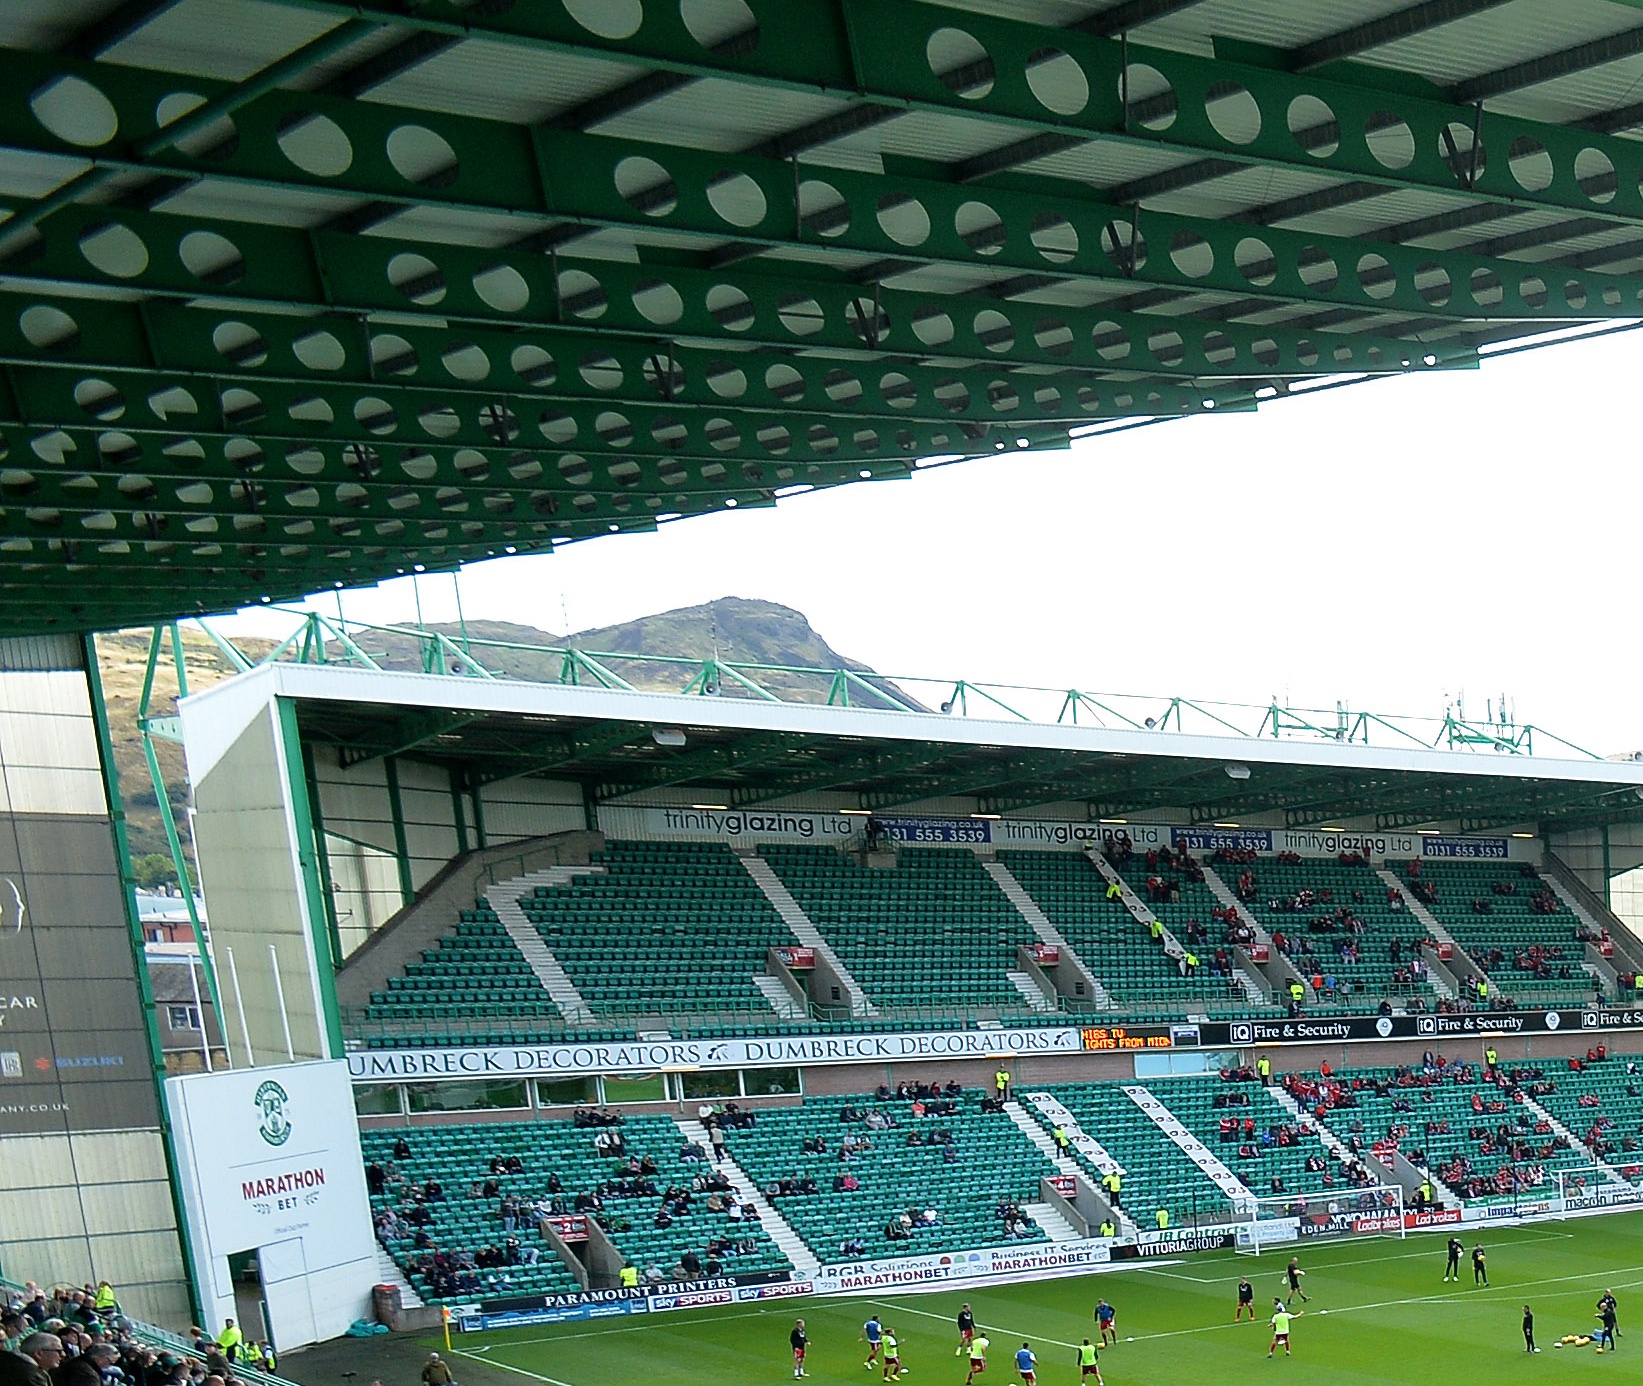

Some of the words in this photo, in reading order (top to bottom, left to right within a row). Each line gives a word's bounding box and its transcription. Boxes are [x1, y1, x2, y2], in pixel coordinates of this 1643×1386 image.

[664, 810, 814, 837] trinityglazing
[821, 816, 852, 835] Ltd
[1005, 822, 1127, 844] trinityglazing
[1133, 827, 1158, 843] Ltd
[916, 829, 943, 841] 555
[949, 830, 985, 842] 3539
[1285, 832, 1386, 854] trinityglazing
[1391, 837, 1412, 851] Ltd
[1427, 846, 1450, 856] 0131
[1455, 846, 1475, 856] 555
[1479, 847, 1504, 857] 3539
[1438, 1019, 1460, 1031] Fire
[1464, 1018, 1474, 1029] &
[1476, 1016, 1524, 1031] Security
[1601, 1013, 1621, 1025] Fire
[1625, 1013, 1633, 1023] &
[1254, 1026, 1281, 1038] Fire
[1283, 1025, 1291, 1036] &
[1293, 1022, 1351, 1038] Security
[746, 1038, 892, 1060] DUMBRECK
[900, 1032, 1049, 1054] DECORATORS
[350, 1052, 504, 1076] UMBRECK
[514, 1044, 700, 1070] DECORATORS
[242, 1168, 325, 1201] MARATHON
[278, 1197, 298, 1211] BET
[563, 1223, 571, 1232] 2
[1357, 1219, 1400, 1232] Ladbrokes
[1416, 1213, 1458, 1225] Ladbrokes
[1137, 1237, 1224, 1256] VITTORIAGROUP
[992, 1252, 1091, 1272] MARATHONBET
[841, 1267, 950, 1288] MARATHONBET
[545, 1286, 651, 1307] PARAMOUNT
[658, 1277, 737, 1295] PRINTERS
[739, 1287, 760, 1299] sky
[763, 1282, 812, 1296] SPORTS
[655, 1296, 676, 1310] sky
[680, 1291, 731, 1305] SPORTS
